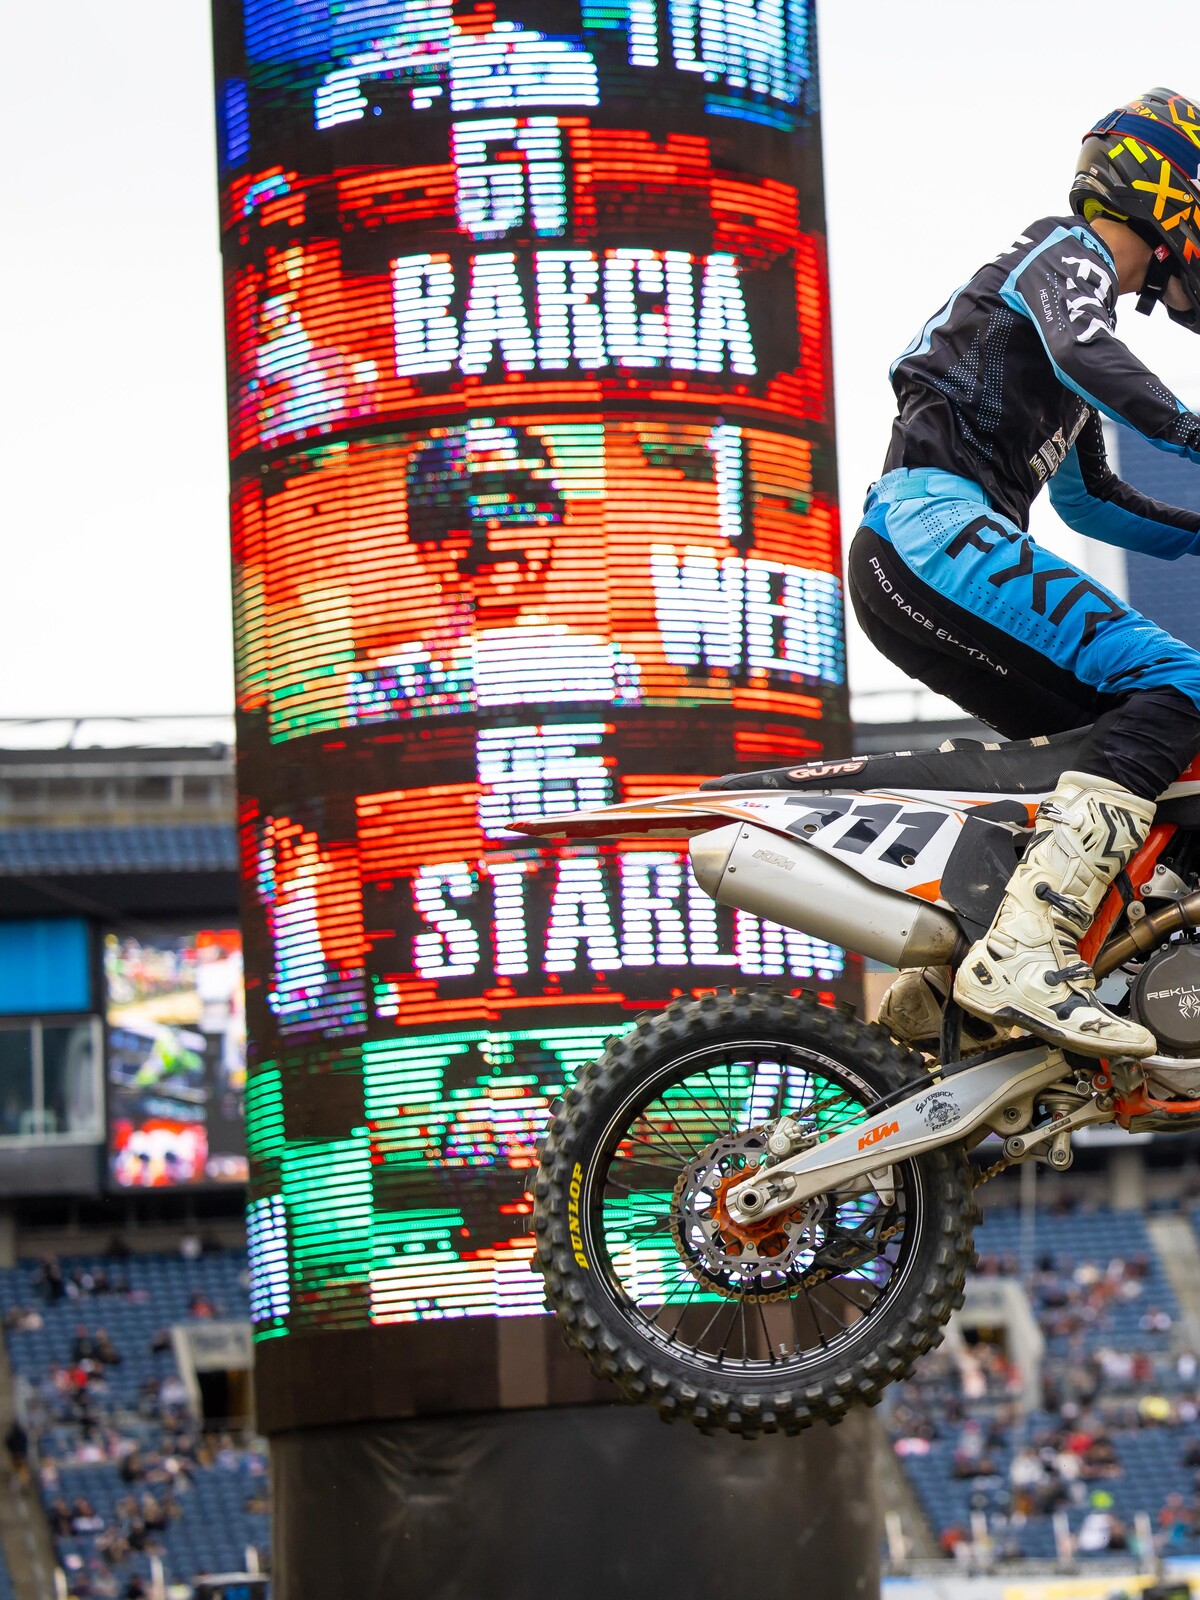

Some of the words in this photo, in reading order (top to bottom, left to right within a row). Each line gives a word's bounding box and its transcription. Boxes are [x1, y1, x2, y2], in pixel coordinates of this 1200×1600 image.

[389, 249, 757, 377] BARCIA
[1040, 288, 1054, 322] HELIUM
[869, 557, 893, 593] PRO
[891, 593, 935, 631] RACE
[944, 514, 1129, 648] FXR
[788, 762, 863, 779] GUTS
[784, 796, 950, 869] 711
[752, 850, 796, 871] KTM
[915, 1091, 954, 1114] SILVERBACK
[858, 1121, 899, 1150] KTM
[568, 1162, 589, 1270] DUNLOP
